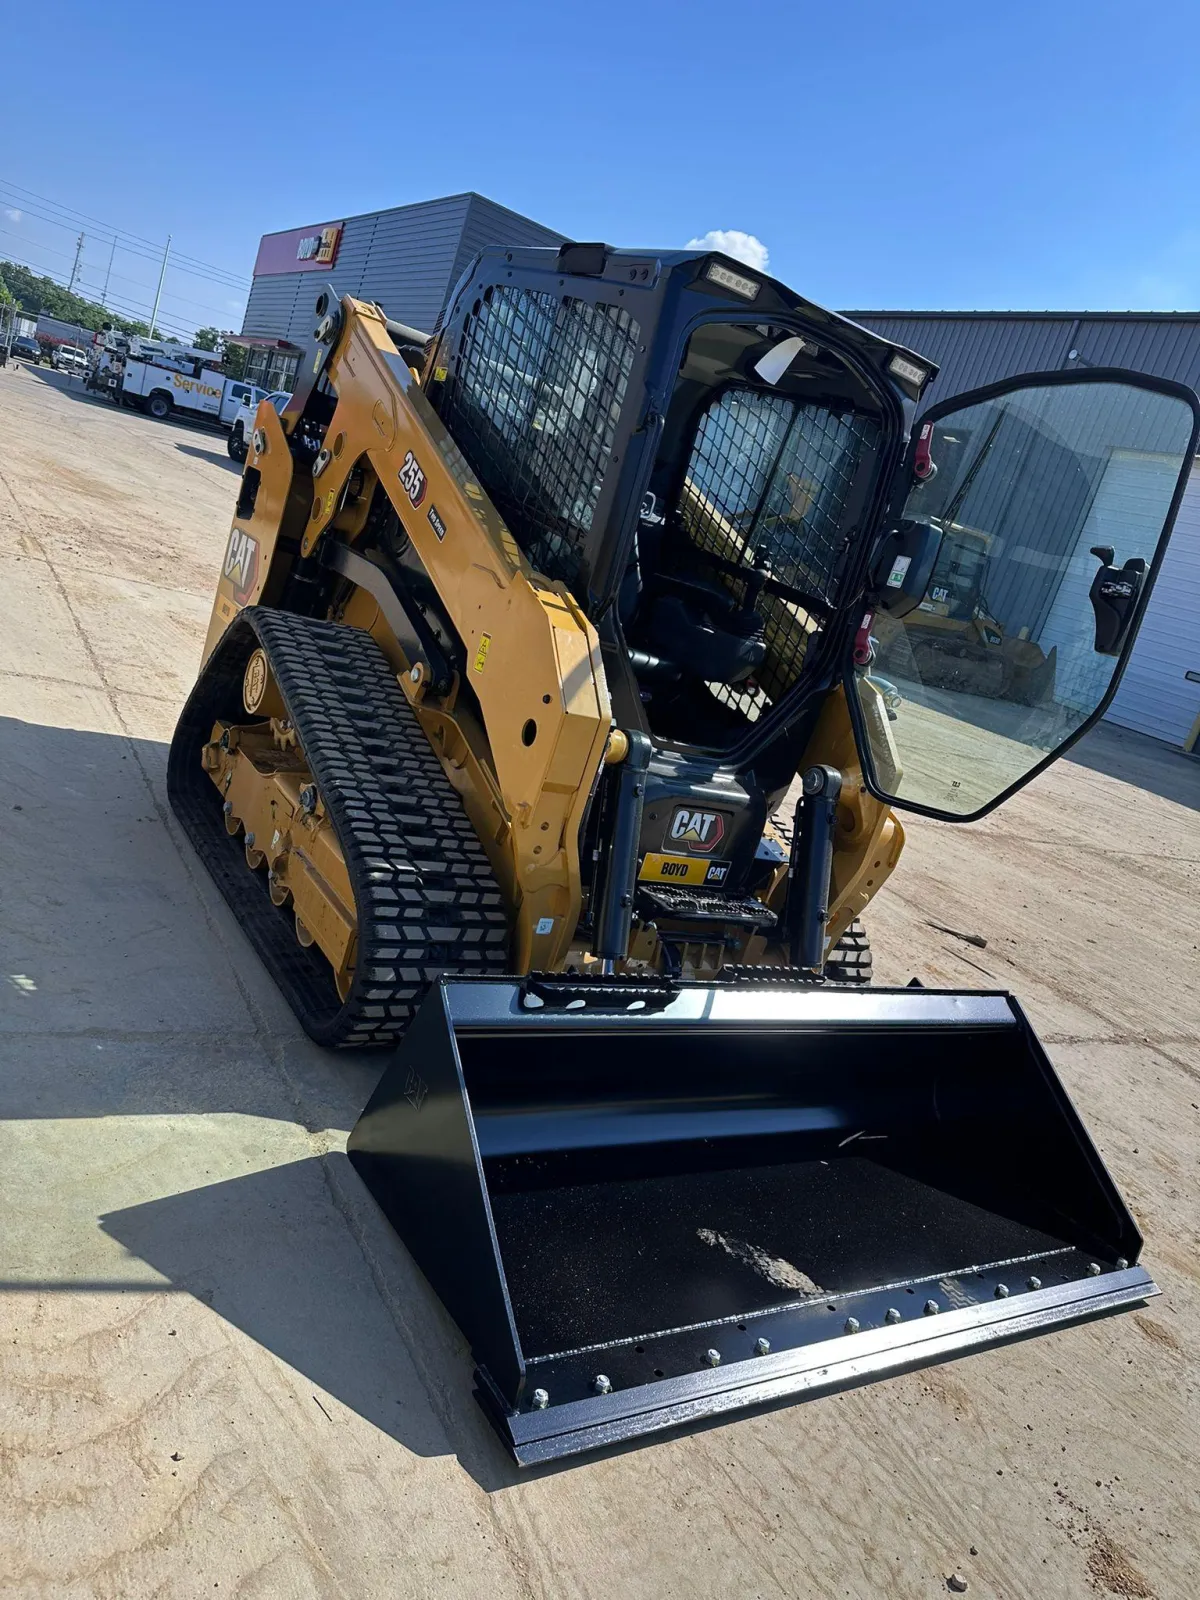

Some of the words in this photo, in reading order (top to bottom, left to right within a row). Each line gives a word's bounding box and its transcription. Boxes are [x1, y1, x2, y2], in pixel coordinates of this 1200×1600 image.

[174, 374, 221, 399] Service
[399, 451, 424, 500] 255
[224, 529, 256, 589] CAT
[932, 587, 949, 602] CAT
[671, 810, 716, 842] CAT
[661, 862, 689, 877] BOYD
[707, 867, 727, 880] CAT
